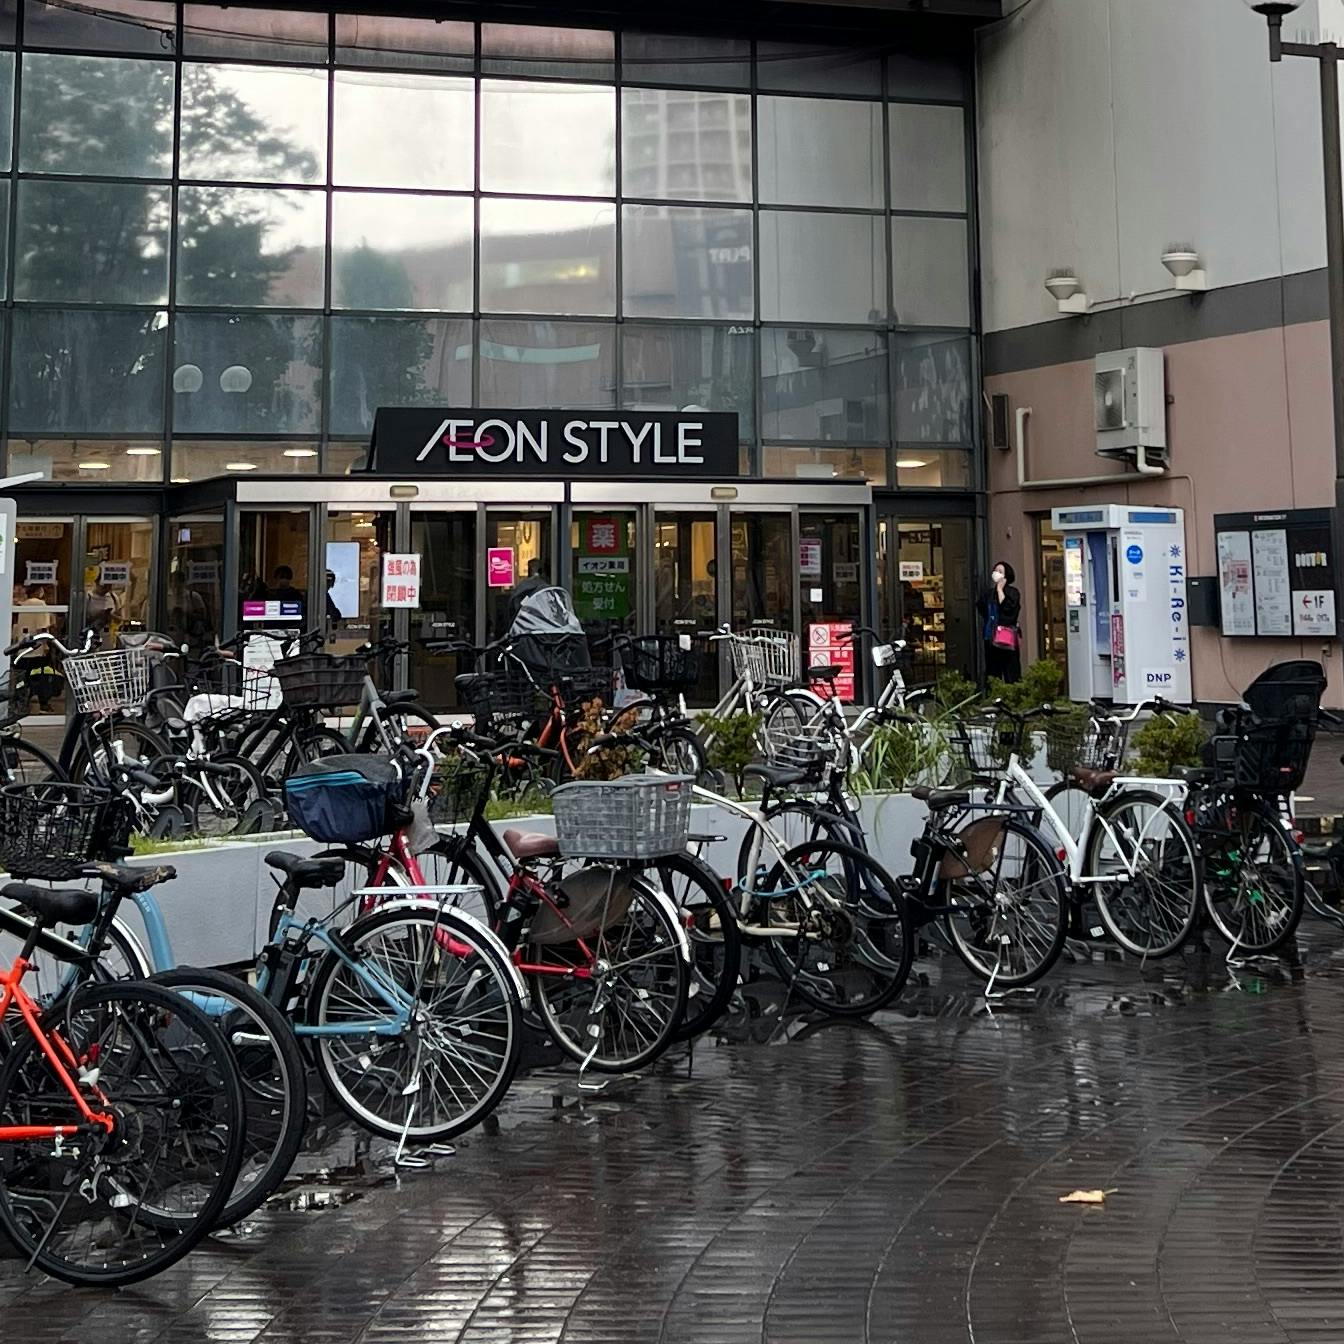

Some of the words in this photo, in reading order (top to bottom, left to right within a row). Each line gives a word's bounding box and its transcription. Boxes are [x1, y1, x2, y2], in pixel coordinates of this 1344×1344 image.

[563, 420, 704, 464] STYLE
[592, 523, 615, 548] 薬
[581, 581, 626, 594] 処方せん
[1147, 673, 1172, 683] DNP
